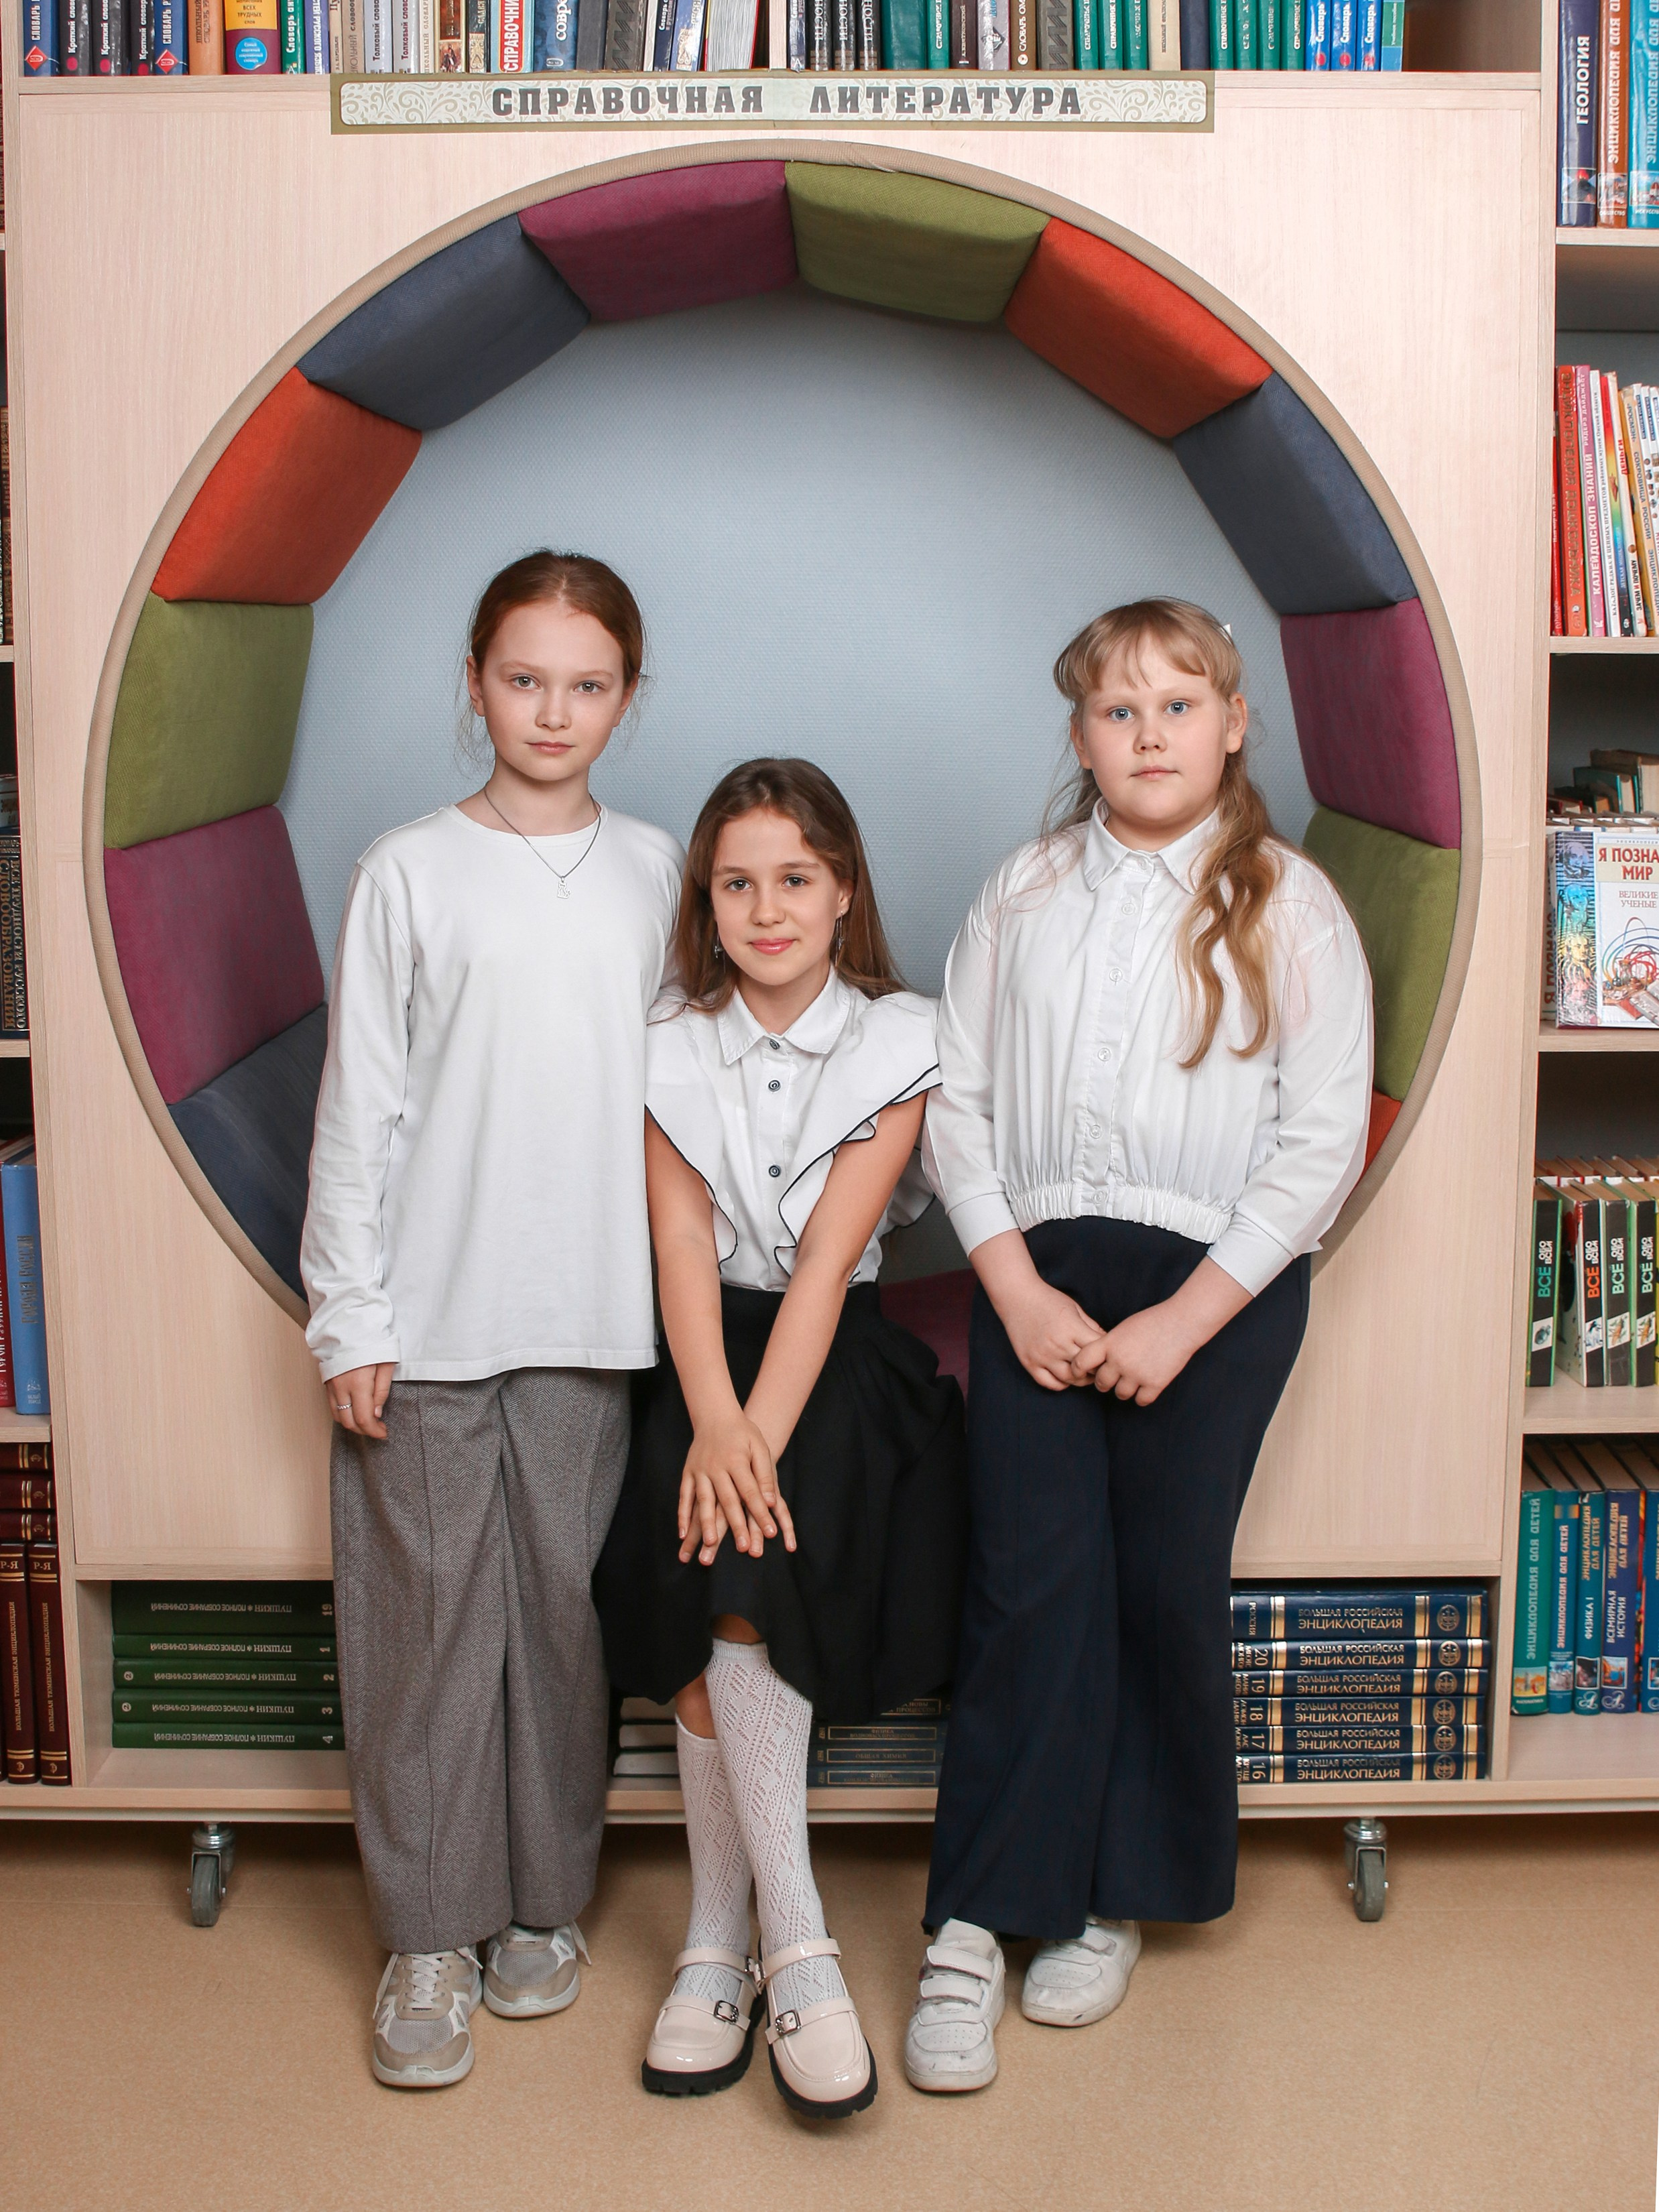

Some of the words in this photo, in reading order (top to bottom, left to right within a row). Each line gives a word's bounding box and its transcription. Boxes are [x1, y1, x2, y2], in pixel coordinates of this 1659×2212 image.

[32, 5, 41, 40] СЛОВАРЬ
[162, 9, 171, 44] СЛОВАРЬ
[659, 3, 668, 31] Словарь
[1109, 4, 1117, 49] СПРАВОЧНИК
[1315, 3, 1326, 42] Словарь
[1340, 4, 1351, 44] Словарь
[1365, 5, 1375, 44] Словарь
[68, 21, 76, 53] Краткий
[101, 23, 109, 55] Краткий
[139, 27, 147, 60] Краткий
[286, 15, 296, 53] Словарь
[313, 16, 322, 51] РУССКОГО
[372, 23, 380, 61] Толковый
[401, 22, 409, 60] Толковый
[1609, 17, 1621, 46] ДЛЯ
[1648, 18, 1659, 46] ДЛЯ
[1576, 36, 1590, 125] ГЕОЛОГИЯ
[491, 85, 763, 116] СПРАВОЧНАЯ
[809, 86, 1082, 115] ЛИТЕРАТУРА
[1608, 50, 1621, 164] ЭНЦИКЛОПЕДИЯ
[1647, 51, 1659, 163] ЭНЦИКЛОПЕДИЯ
[1559, 373, 1577, 485] ЭНЦИКЛОПЕДИЯ
[1617, 439, 1628, 475] ДЕНЬГИ
[1584, 454, 1595, 501] ЗНАНИЙ
[1634, 452, 1646, 503] СОКРОВИЩА
[1642, 507, 1652, 540] РОССИИ
[1565, 490, 1581, 597] ДОШКОЛЬНИКА
[1588, 506, 1601, 595] КАЛЕЙДОСКОП
[1631, 560, 1640, 584] ПОЧЕМУ
[1609, 586, 1617, 616] КАТАЛОГ
[1633, 590, 1642, 611] ЗАЧЕМ
[1598, 847, 1607, 862] Я
[10, 860, 21, 884] ВСЕ
[1622, 865, 1653, 880] МИР
[1619, 890, 1658, 899] ВЕЛИКИЕ
[1621, 900, 1657, 908] УЧЕНЫЕ
[11, 885, 24, 961] ТРУДНОСТИ
[15, 963, 26, 1029] РУССКОГО
[17, 1235, 35, 1277] РОССИИ
[19, 1281, 38, 1324] ГОРОДА
[1529, 1497, 1541, 1534] ДЕТЕЙ
[1559, 1524, 1569, 1553] ДЕТЕЙ
[1581, 1505, 1591, 1581] ЭНЦИКЛОПЕДИЯ
[1591, 1517, 1600, 1547] ДЕТЕЙ
[1608, 1501, 1619, 1579] ЭНЦИКЛОПЕДИЯ
[1619, 1515, 1628, 1545] ДЕТЕЙ
[1530, 1538, 1540, 1562] ДЛЯ
[1591, 1550, 1600, 1570] ДЛЯ
[1618, 1548, 1627, 1568] ДЛЯ
[34, 1561, 52, 1570] Р-Я
[1560, 1556, 1568, 1574] ДЛЯ
[151, 1603, 188, 1611] СОЧИНЕНИЙ
[188, 1603, 221, 1611] СОБРАНИЕ
[254, 1604, 292, 1613] ПУШКИН
[1248, 1601, 1257, 1636] РОССИЯ
[1344, 1607, 1403, 1616] РОССИЙСКАЯ
[1526, 1566, 1538, 1660] ЭНЦИКЛОПЕДИЯ
[1556, 1577, 1567, 1648] ЭНЦИКЛОПЕДИЯ
[1606, 1590, 1616, 1643] ВСЕМИРНАЯ
[1616, 1597, 1626, 1638] ИСТОРИЯ
[9, 1601, 17, 1655] ЭНЦИКЛОПЕДИЯ
[42, 1602, 51, 1656] ЭНЦИКЛОПЕДИЯ
[1298, 1619, 1403, 1630] ЭНЦИКЛОПЕДИЯ
[1585, 1603, 1594, 1640] ФИЗИКА
[150, 1643, 188, 1651] СОЧИНЕНИЙ
[188, 1644, 220, 1652] СОБРАНИЕ
[221, 1644, 245, 1652] ПОЛНОЕ
[253, 1644, 292, 1653] ПУШКИН
[1254, 1648, 1268, 1666] 20
[1299, 1645, 1343, 1654] БОЛЬШАЯ
[1345, 1643, 1404, 1652] РОССИЙСКАЯ
[1300, 1655, 1404, 1666] ЭНЦИКЛОПЕДИЯ
[12, 1656, 20, 1697] ТЮМЕНСКАЯ
[45, 1657, 53, 1699] ТЮМЕНСКАЯ
[154, 1672, 192, 1680] СОЧИНЕНИЙ
[192, 1672, 225, 1680] СОБРАНИЕ
[258, 1673, 296, 1681] ПУШКИН
[1251, 1678, 1266, 1693] 19
[1297, 1674, 1339, 1683] БОЛЬШАЯ
[1342, 1673, 1401, 1682] РОССИЙСКАЯ
[1296, 1684, 1401, 1695] ЭНЦИКЛОПЕДИЯ
[152, 1704, 190, 1712] СОЧИНЕНИЙ
[223, 1705, 248, 1713] ПОЛНОЕ
[256, 1705, 294, 1713] ПУШКИН
[321, 1707, 332, 1715] 3
[1249, 1705, 1264, 1721] 18
[1294, 1703, 1337, 1711] БОЛЬШАЯ
[1340, 1701, 1399, 1710] РОССИЙСКАЯ
[1294, 1713, 1399, 1723] ЭНЦИКЛОПЕДИЯ
[153, 1733, 191, 1741] СОЧИНЕНИЙ
[192, 1733, 223, 1741] СОБРАНИЕ
[257, 1735, 295, 1743] ПУШКИН
[322, 1735, 333, 1743] 4
[1251, 1733, 1265, 1749] 17
[1296, 1729, 1339, 1737] БОЛЬШАЯ
[1341, 1728, 1400, 1737] РОССИЙСКАЯ
[1296, 1739, 1400, 1750] ЭНЦИКЛОПЕДИЯ
[1252, 1762, 1266, 1780] 16
[1297, 1759, 1339, 1768] БОЛЬШАЯ
[1342, 1758, 1401, 1766] РОССИЙСКАЯ
[1297, 1769, 1400, 1780] ЭНЦИКЛОПЕДИЯ
